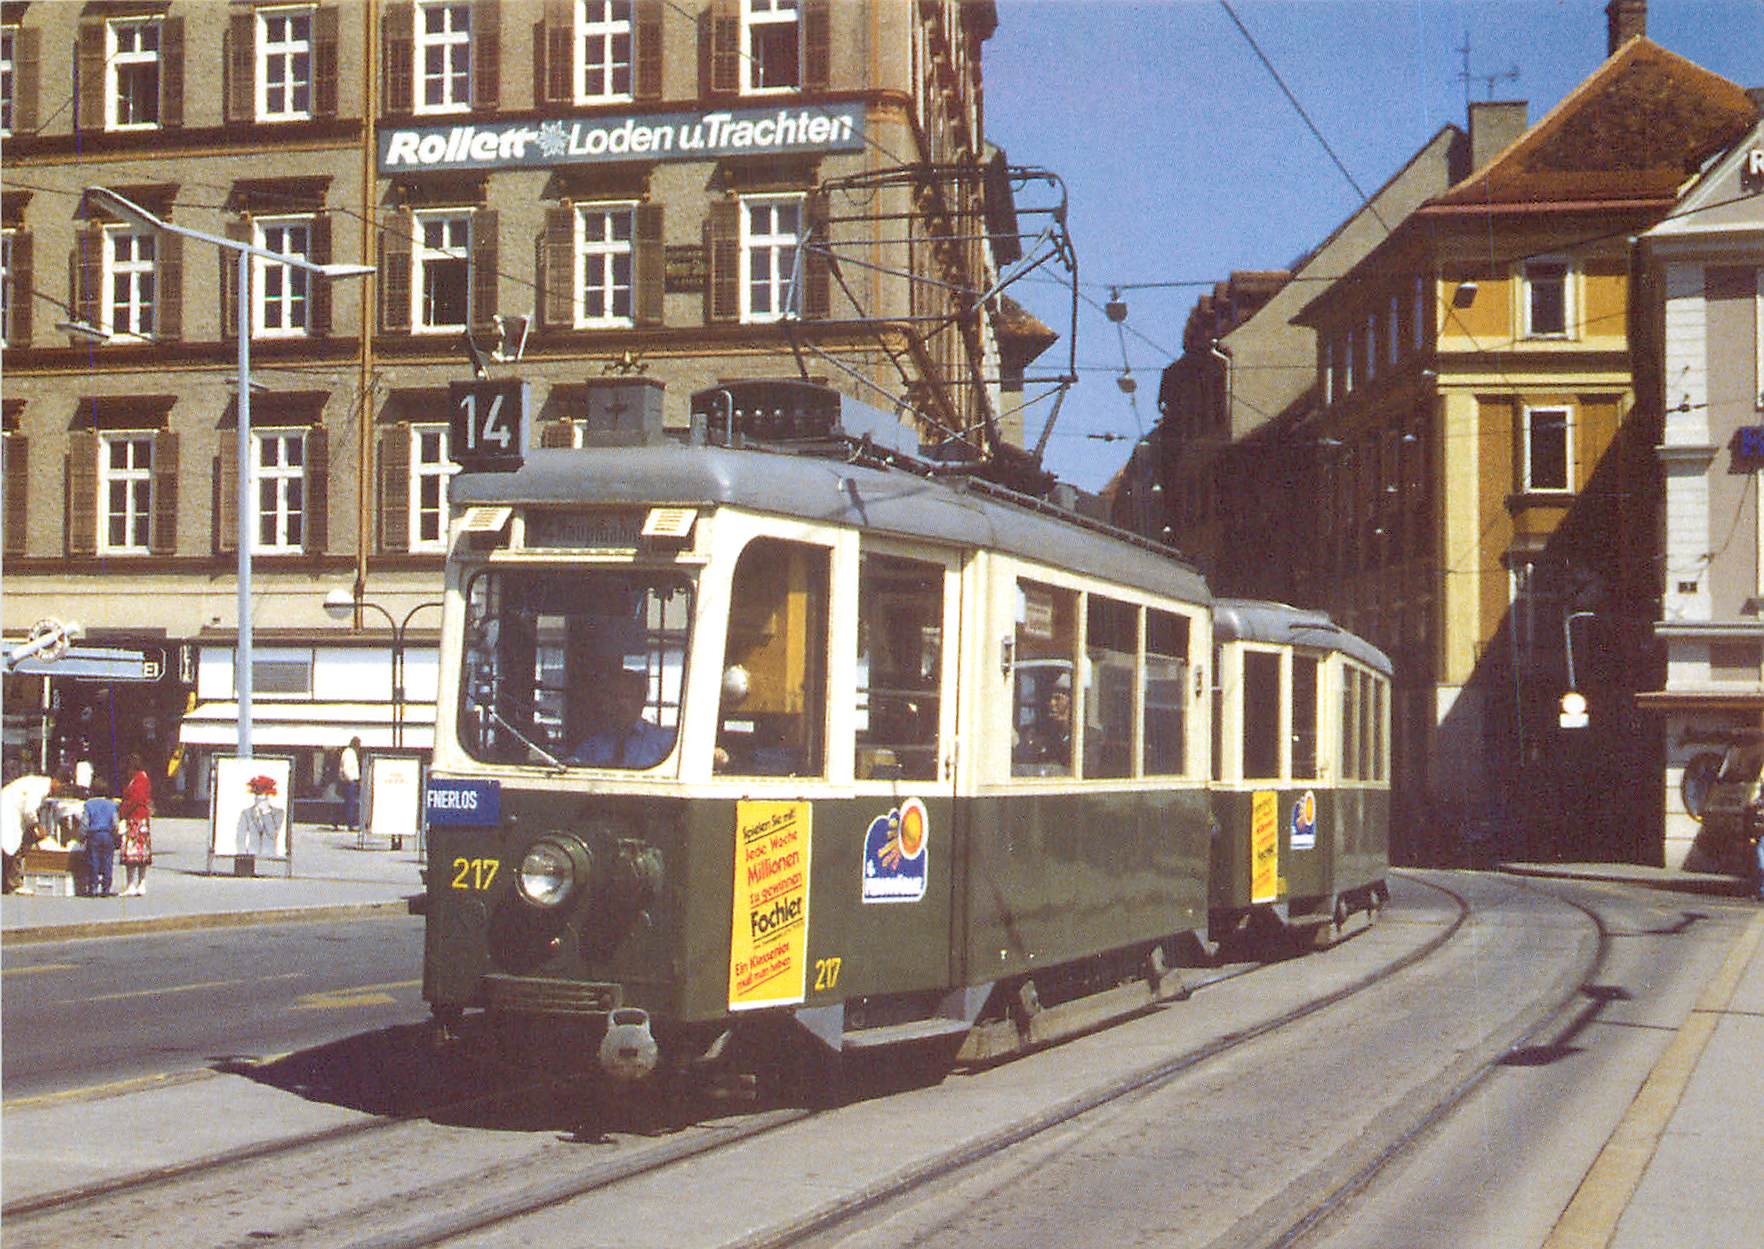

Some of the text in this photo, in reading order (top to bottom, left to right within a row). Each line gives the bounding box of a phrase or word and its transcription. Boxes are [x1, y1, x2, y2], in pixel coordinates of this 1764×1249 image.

[385, 126, 538, 165] Rollett
[569, 119, 673, 154] Loden
[459, 394, 512, 448] 14
[769, 830, 798, 850] Woche
[451, 857, 499, 891] 217
[748, 851, 800, 887] Millionen
[761, 871, 802, 903] gewinnen
[751, 896, 802, 937] Fochler
[735, 961, 749, 976] Ein
[814, 957, 841, 991] 217
